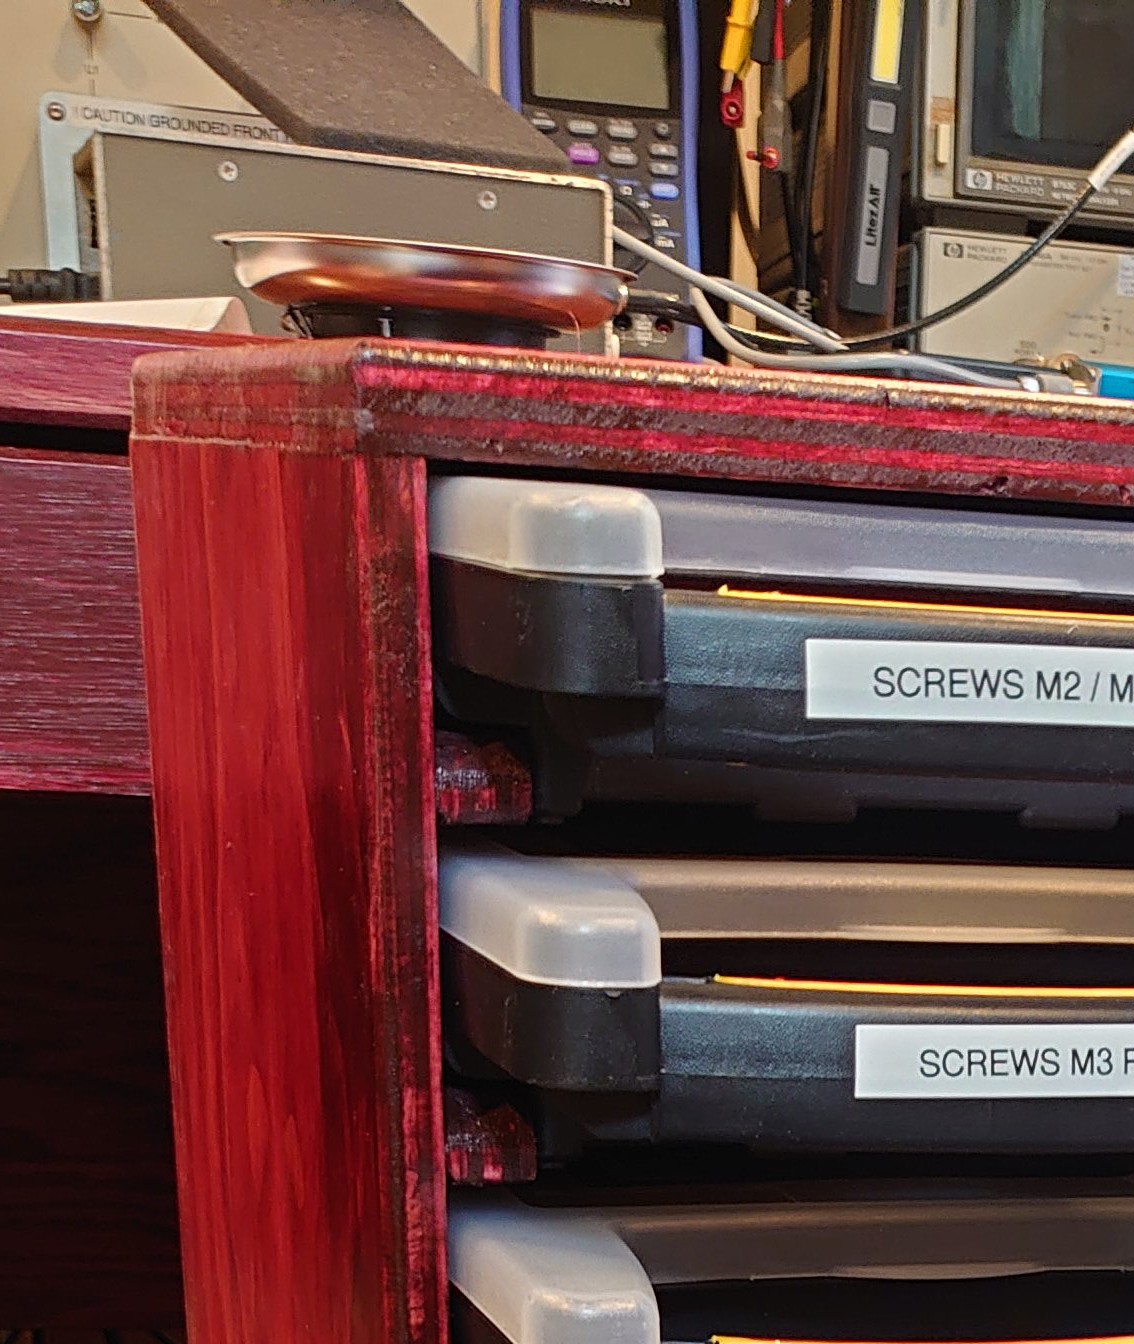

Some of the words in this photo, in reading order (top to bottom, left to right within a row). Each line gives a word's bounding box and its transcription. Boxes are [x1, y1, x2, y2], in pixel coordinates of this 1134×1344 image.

[83, 106, 146, 126] CAUTION
[150, 114, 230, 136] GROUNDED
[233, 124, 280, 141] FRONT
[995, 173, 1045, 187] HEWLETT
[996, 183, 1045, 197] PACKARD
[873, 666, 1025, 700] SCREWS
[1036, 670, 1081, 701] M2
[1089, 671, 1101, 703] /
[919, 1047, 1061, 1078] SCREWS
[1071, 1046, 1114, 1076] M3
